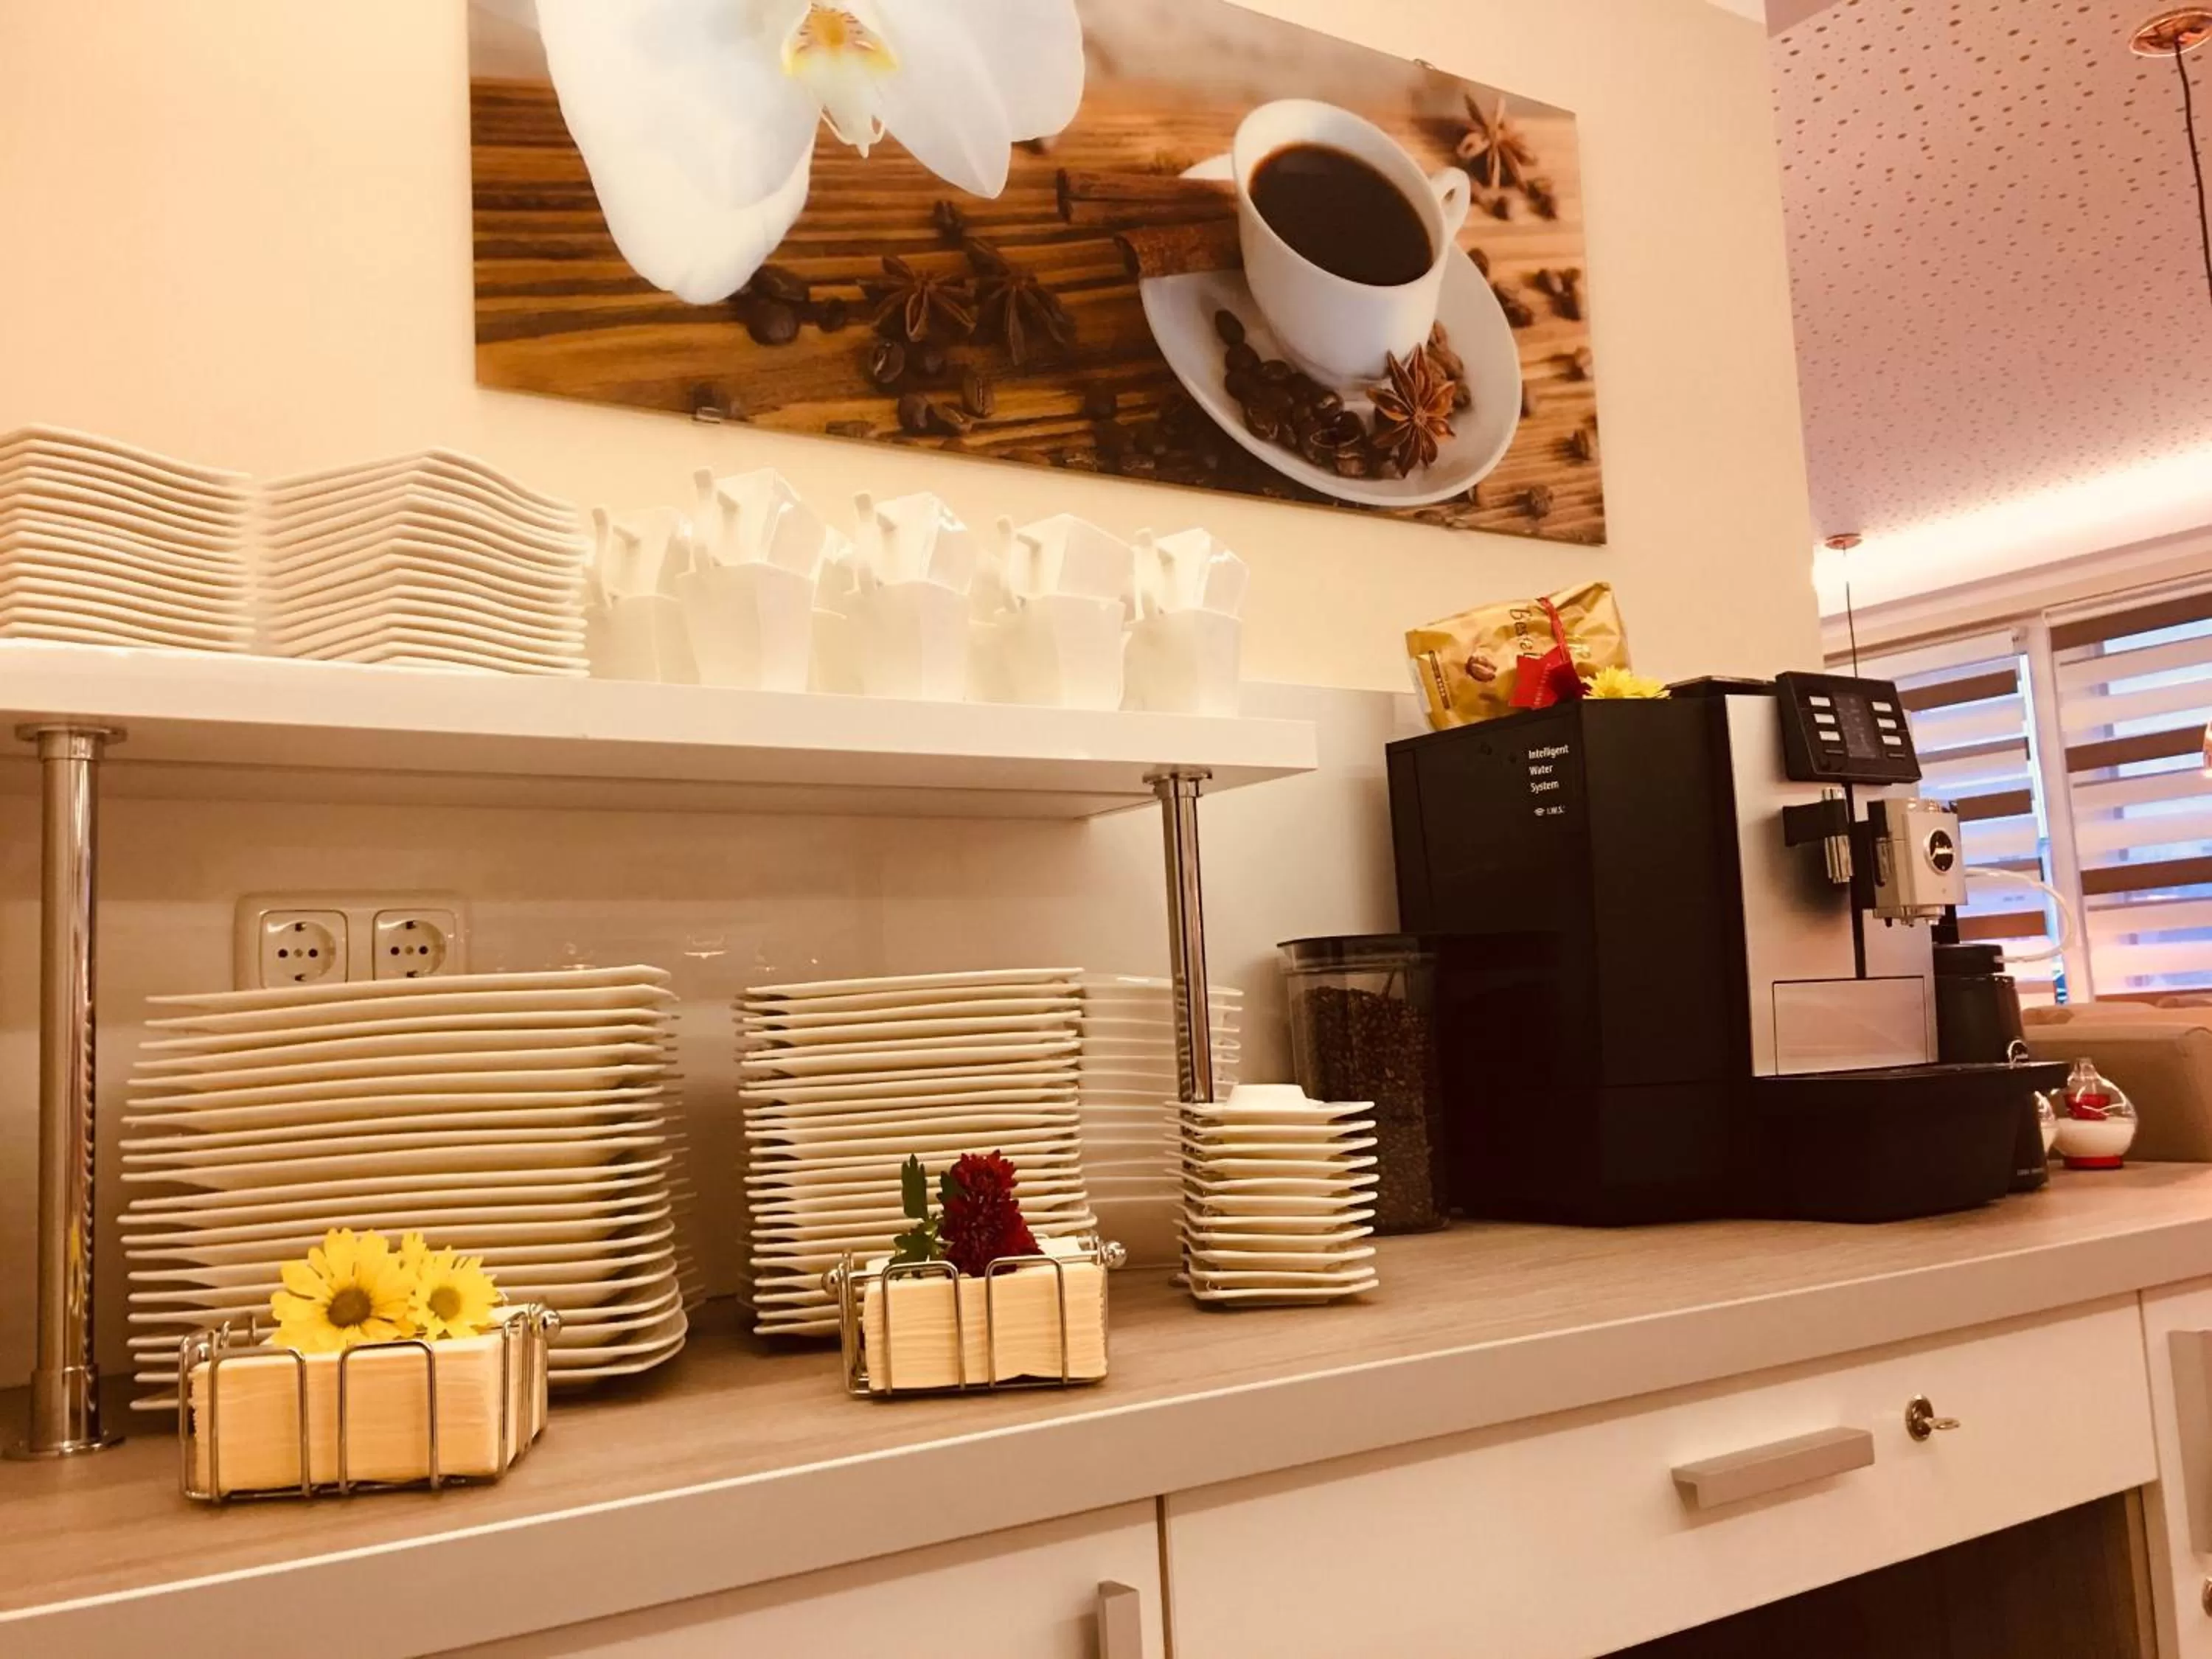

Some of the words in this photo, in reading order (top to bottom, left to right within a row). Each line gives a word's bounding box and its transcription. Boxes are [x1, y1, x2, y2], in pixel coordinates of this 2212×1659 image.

[1528, 744, 1569, 759] Intelligent
[1529, 765, 1554, 776] Water
[1530, 782, 1559, 793] System
